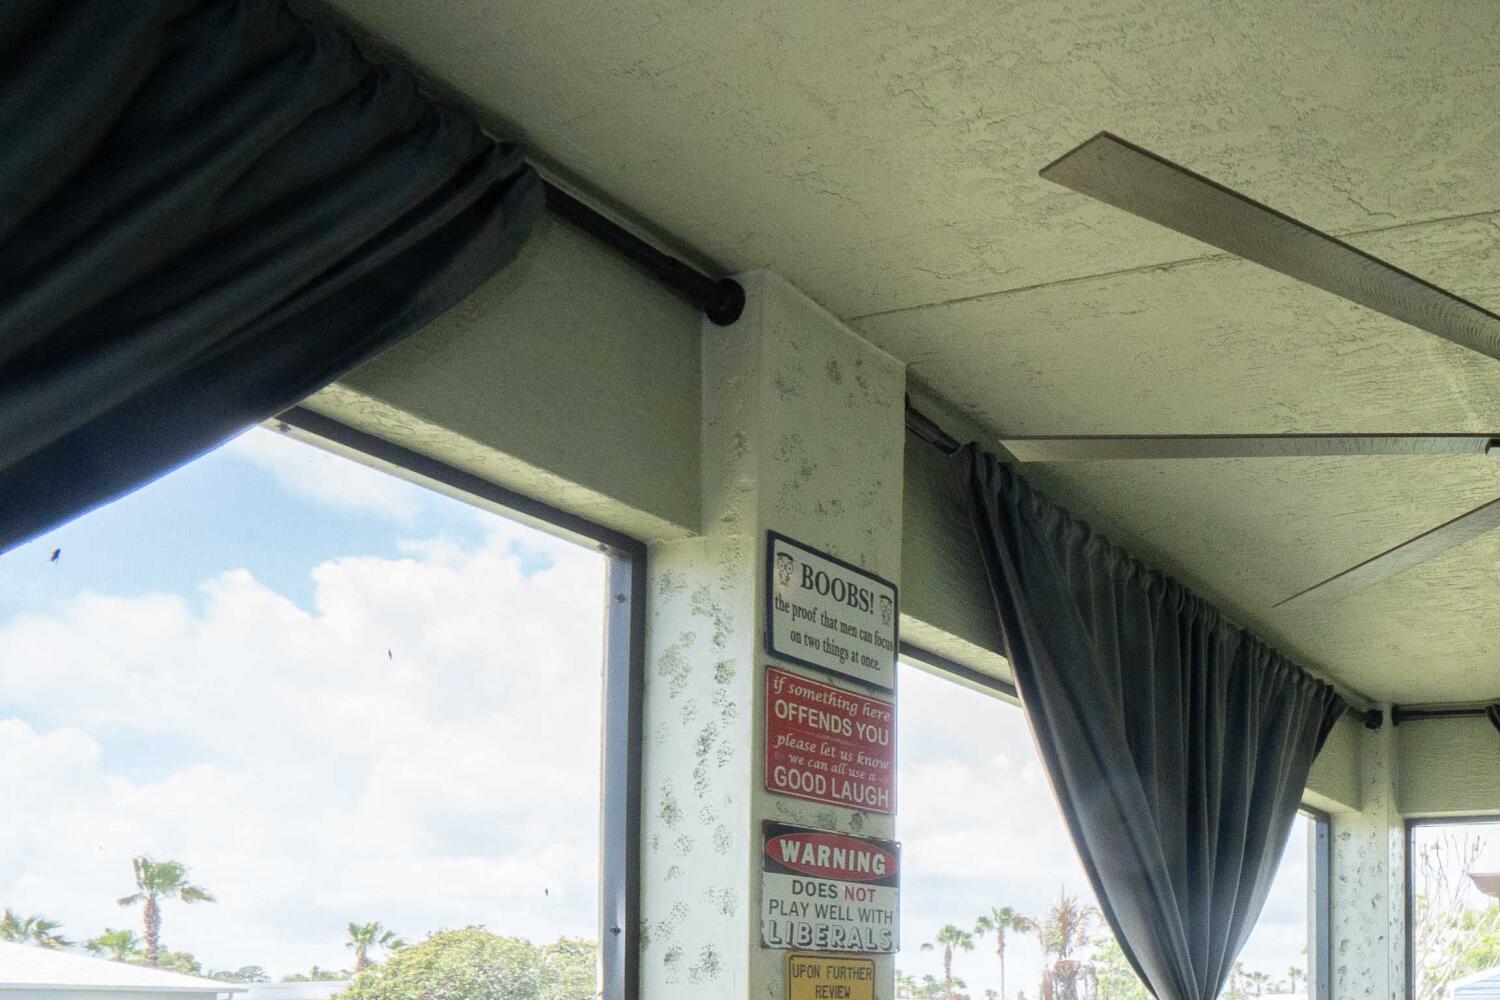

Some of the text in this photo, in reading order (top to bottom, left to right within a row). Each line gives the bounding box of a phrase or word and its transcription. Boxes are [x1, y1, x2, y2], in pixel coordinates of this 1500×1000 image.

[801, 563, 874, 614] BOOBS!
[775, 594, 893, 651] the proof that men can focus
[790, 630, 881, 671] on two things at once.
[773, 675, 890, 721] if something here
[775, 699, 888, 745] OFFENDS YOU
[774, 733, 890, 769] please let us know
[788, 754, 876, 782] we can all use a
[774, 766, 889, 808] GOOD LAUGH
[780, 839, 885, 875] WARNING
[792, 880, 876, 902] DOES NOT
[769, 899, 893, 925] PLAY WELL WITH
[768, 920, 893, 951] LIBERALS
[792, 964, 873, 981] UPON FURTHER
[815, 985, 851, 999] REVIEW
